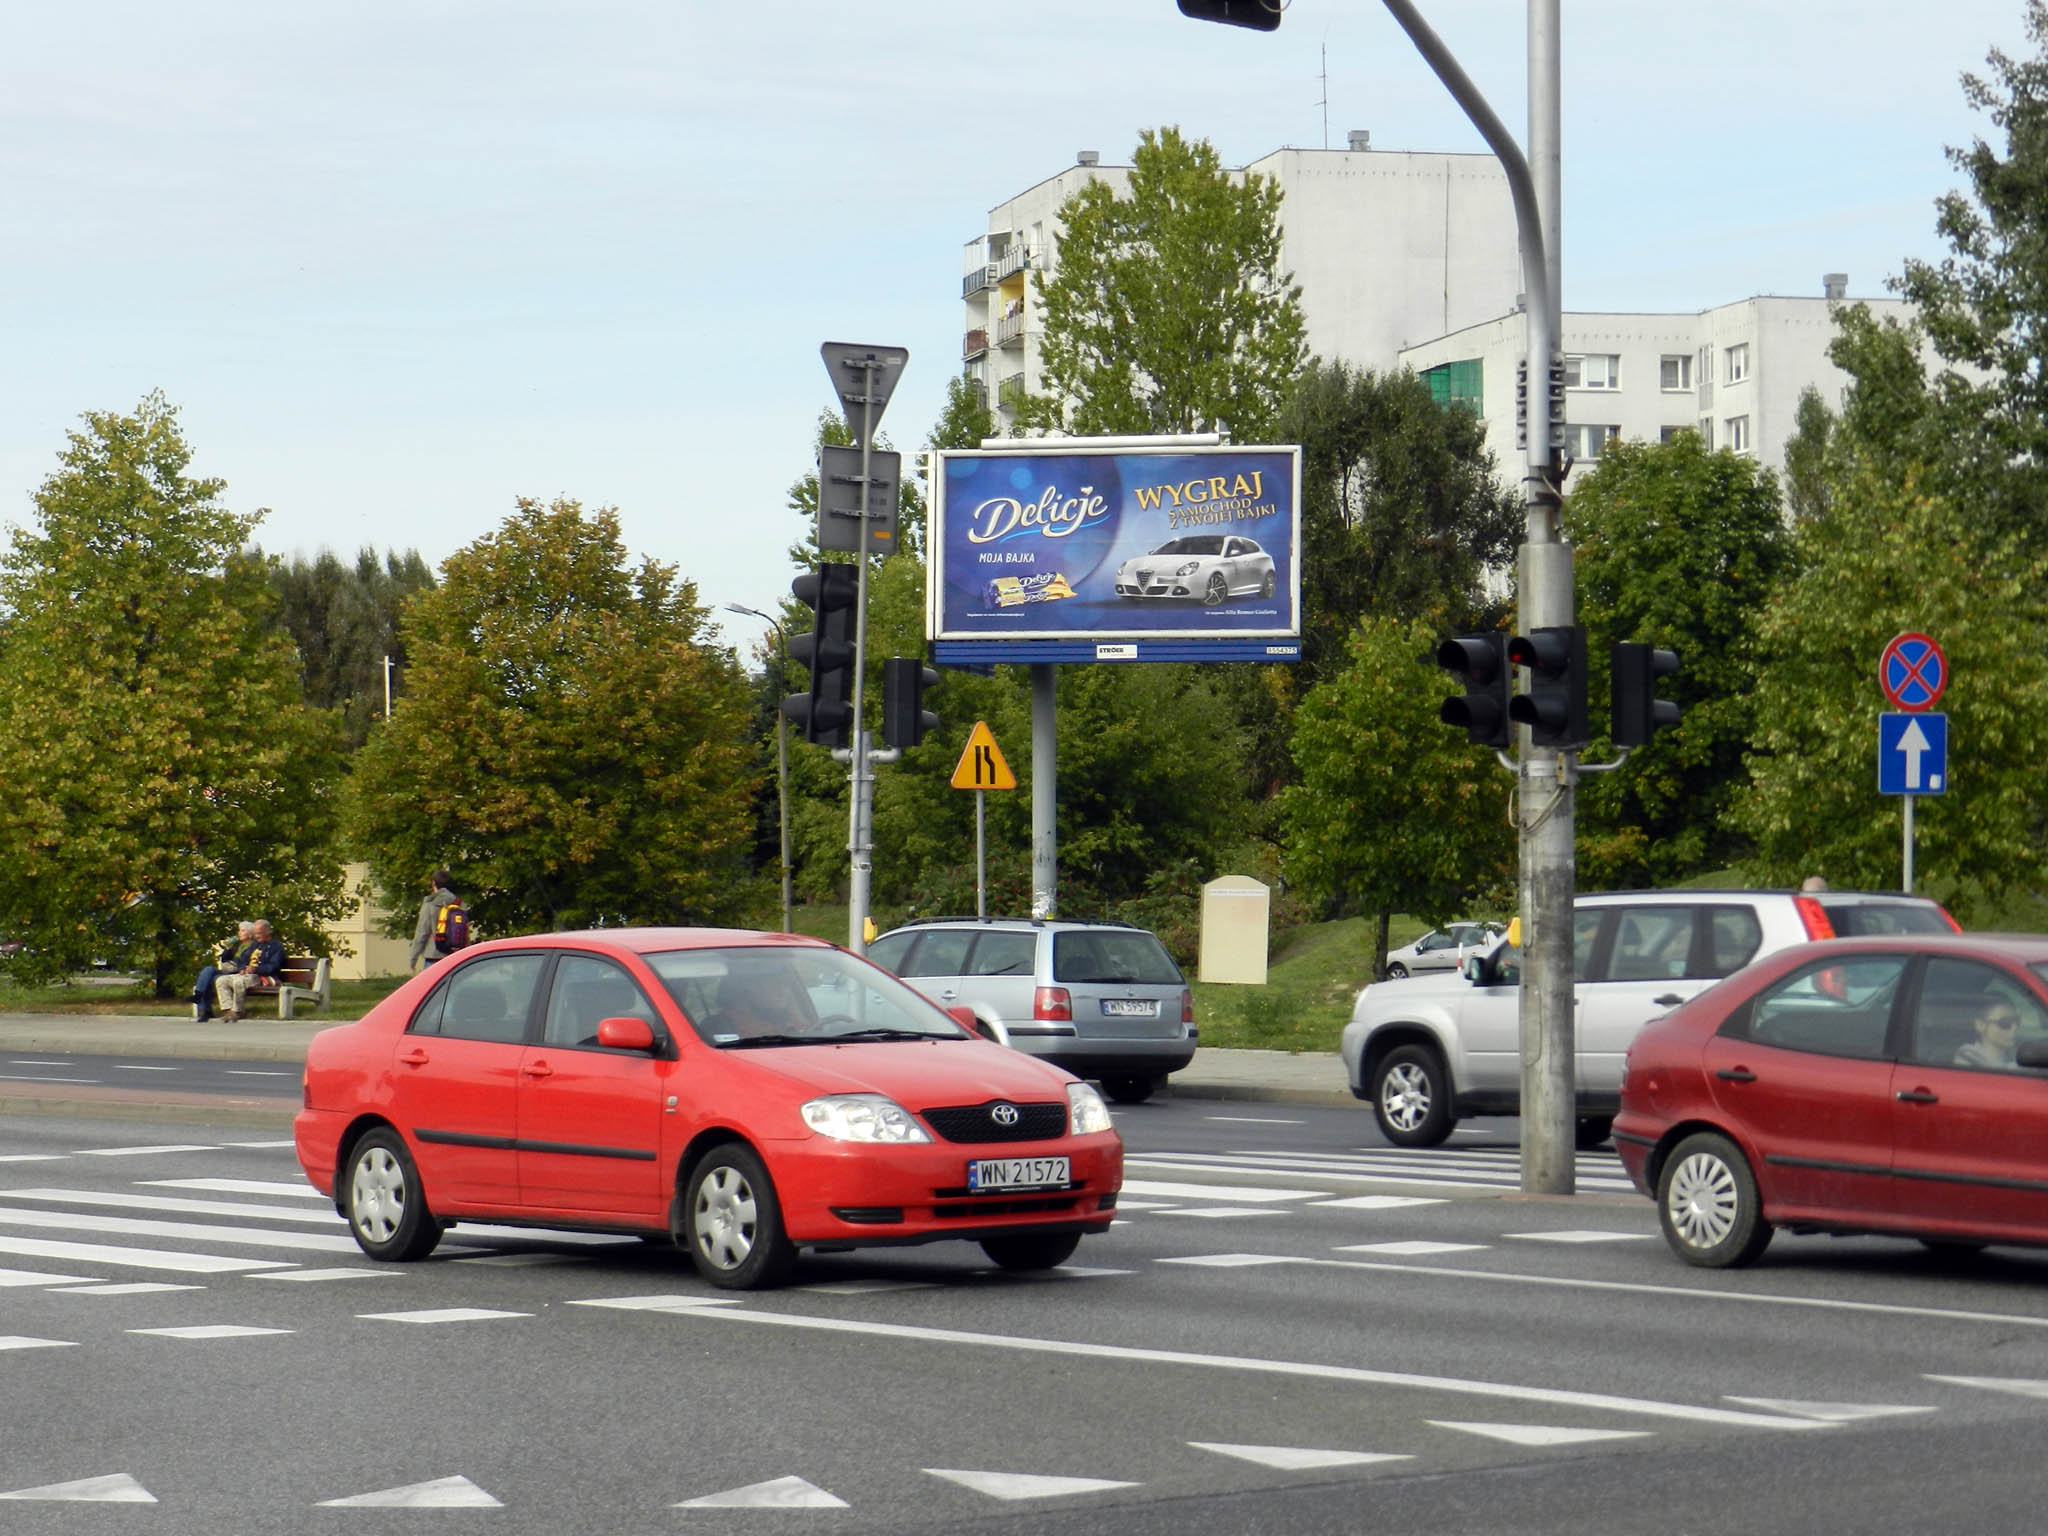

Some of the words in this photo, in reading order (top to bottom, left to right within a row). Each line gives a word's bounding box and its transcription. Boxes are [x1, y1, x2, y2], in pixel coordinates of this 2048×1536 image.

[1134, 471, 1263, 511] WYGRAJ
[967, 485, 1109, 544] Delicje
[1168, 496, 1252, 519] SAMOCHÓD
[1170, 519, 1179, 530] Z
[1182, 511, 1233, 527] TWOJEJ
[1237, 503, 1277, 520] BAJKI
[979, 552, 1003, 563] MOJA
[1006, 552, 1035, 563] BAJKA
[981, 1162, 1006, 1185] WN
[1012, 1160, 1066, 1183] 21572
